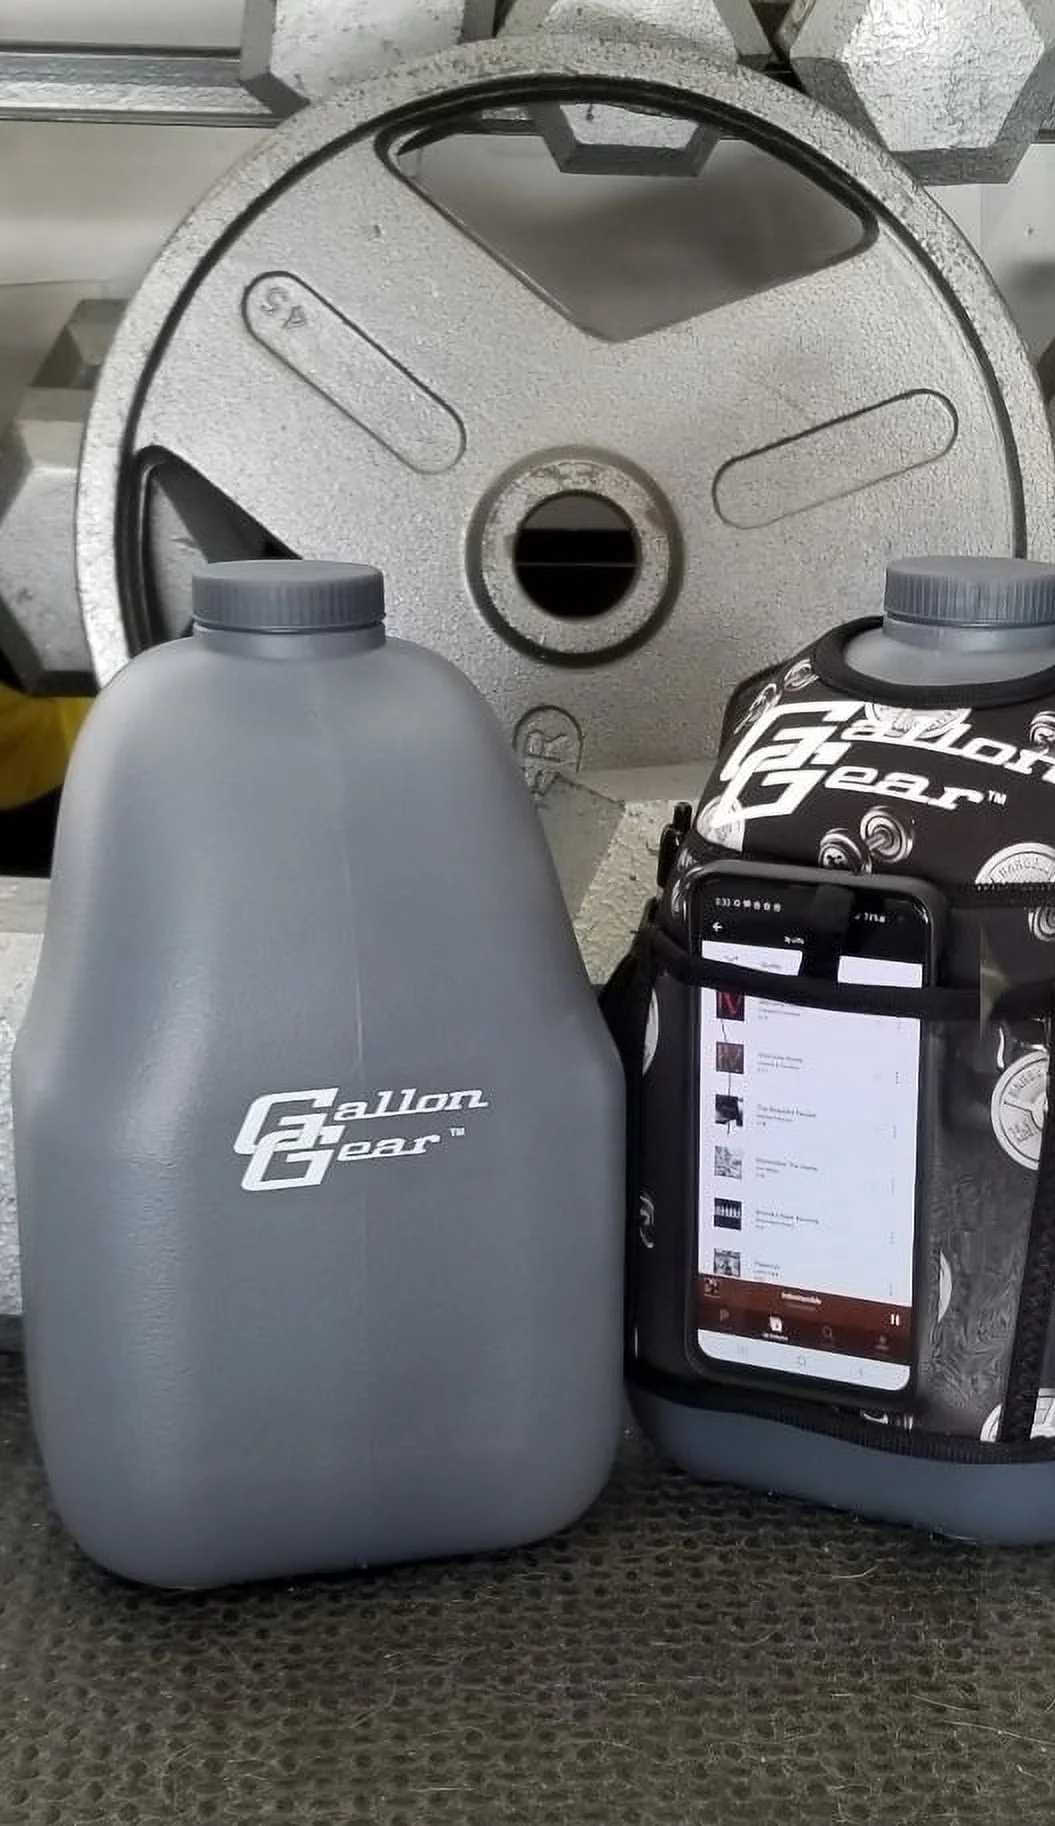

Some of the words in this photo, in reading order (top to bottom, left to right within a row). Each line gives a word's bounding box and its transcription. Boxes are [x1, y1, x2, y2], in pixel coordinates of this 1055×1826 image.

[709, 741, 985, 829] Gear
[233, 1087, 490, 1156] Gallon
[240, 1125, 441, 1191] Gear
